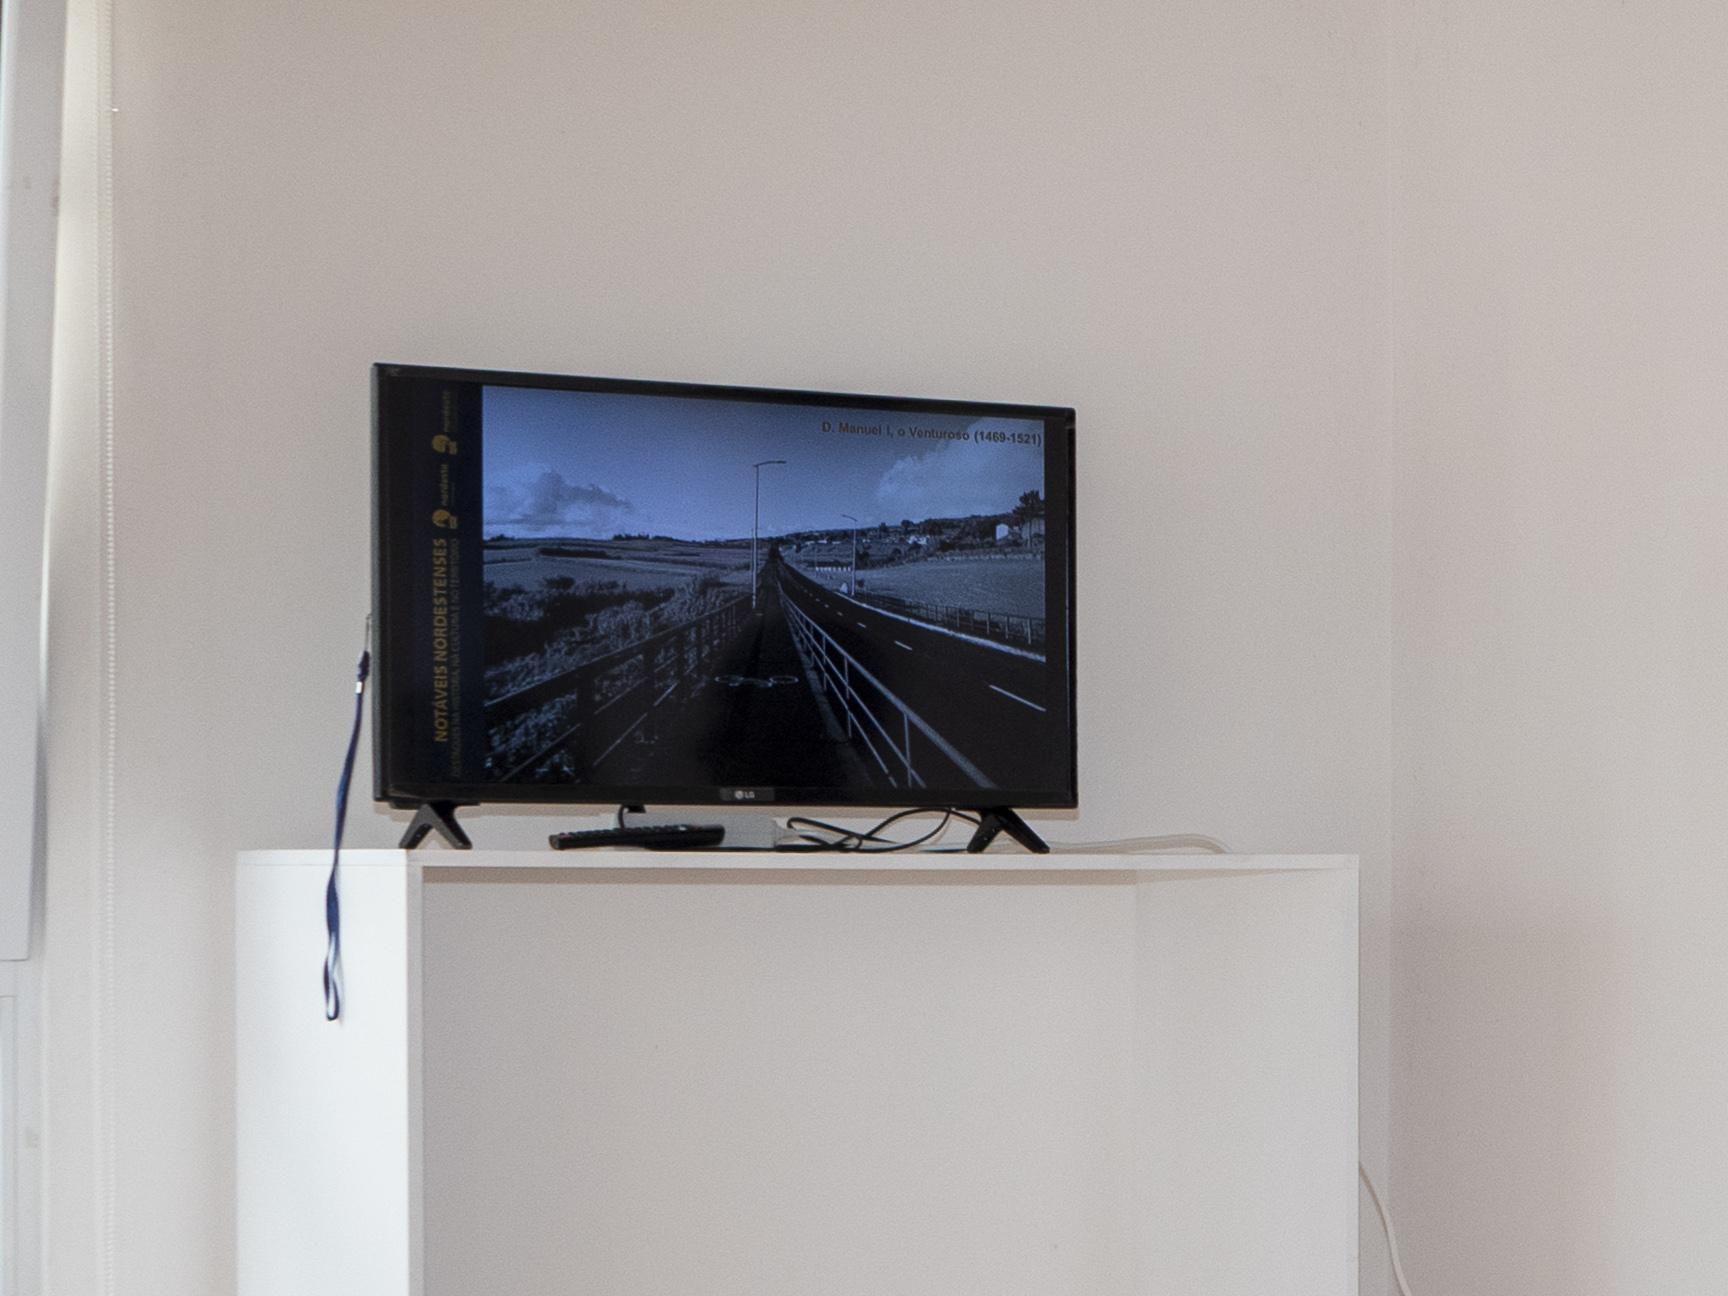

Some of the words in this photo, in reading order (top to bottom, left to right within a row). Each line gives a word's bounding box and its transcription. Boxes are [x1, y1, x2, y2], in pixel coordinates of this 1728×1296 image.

[821, 420, 833, 433] D.
[838, 421, 881, 436] Manuel
[886, 424, 894, 438] I,
[896, 426, 905, 437] o
[908, 425, 970, 441] Venturoso
[973, 429, 1042, 447] (1469-1521)
[432, 538, 448, 661] NORDESTENSES
[432, 664, 448, 741] NOTÁVEIS
[744, 791, 755, 799] LG
